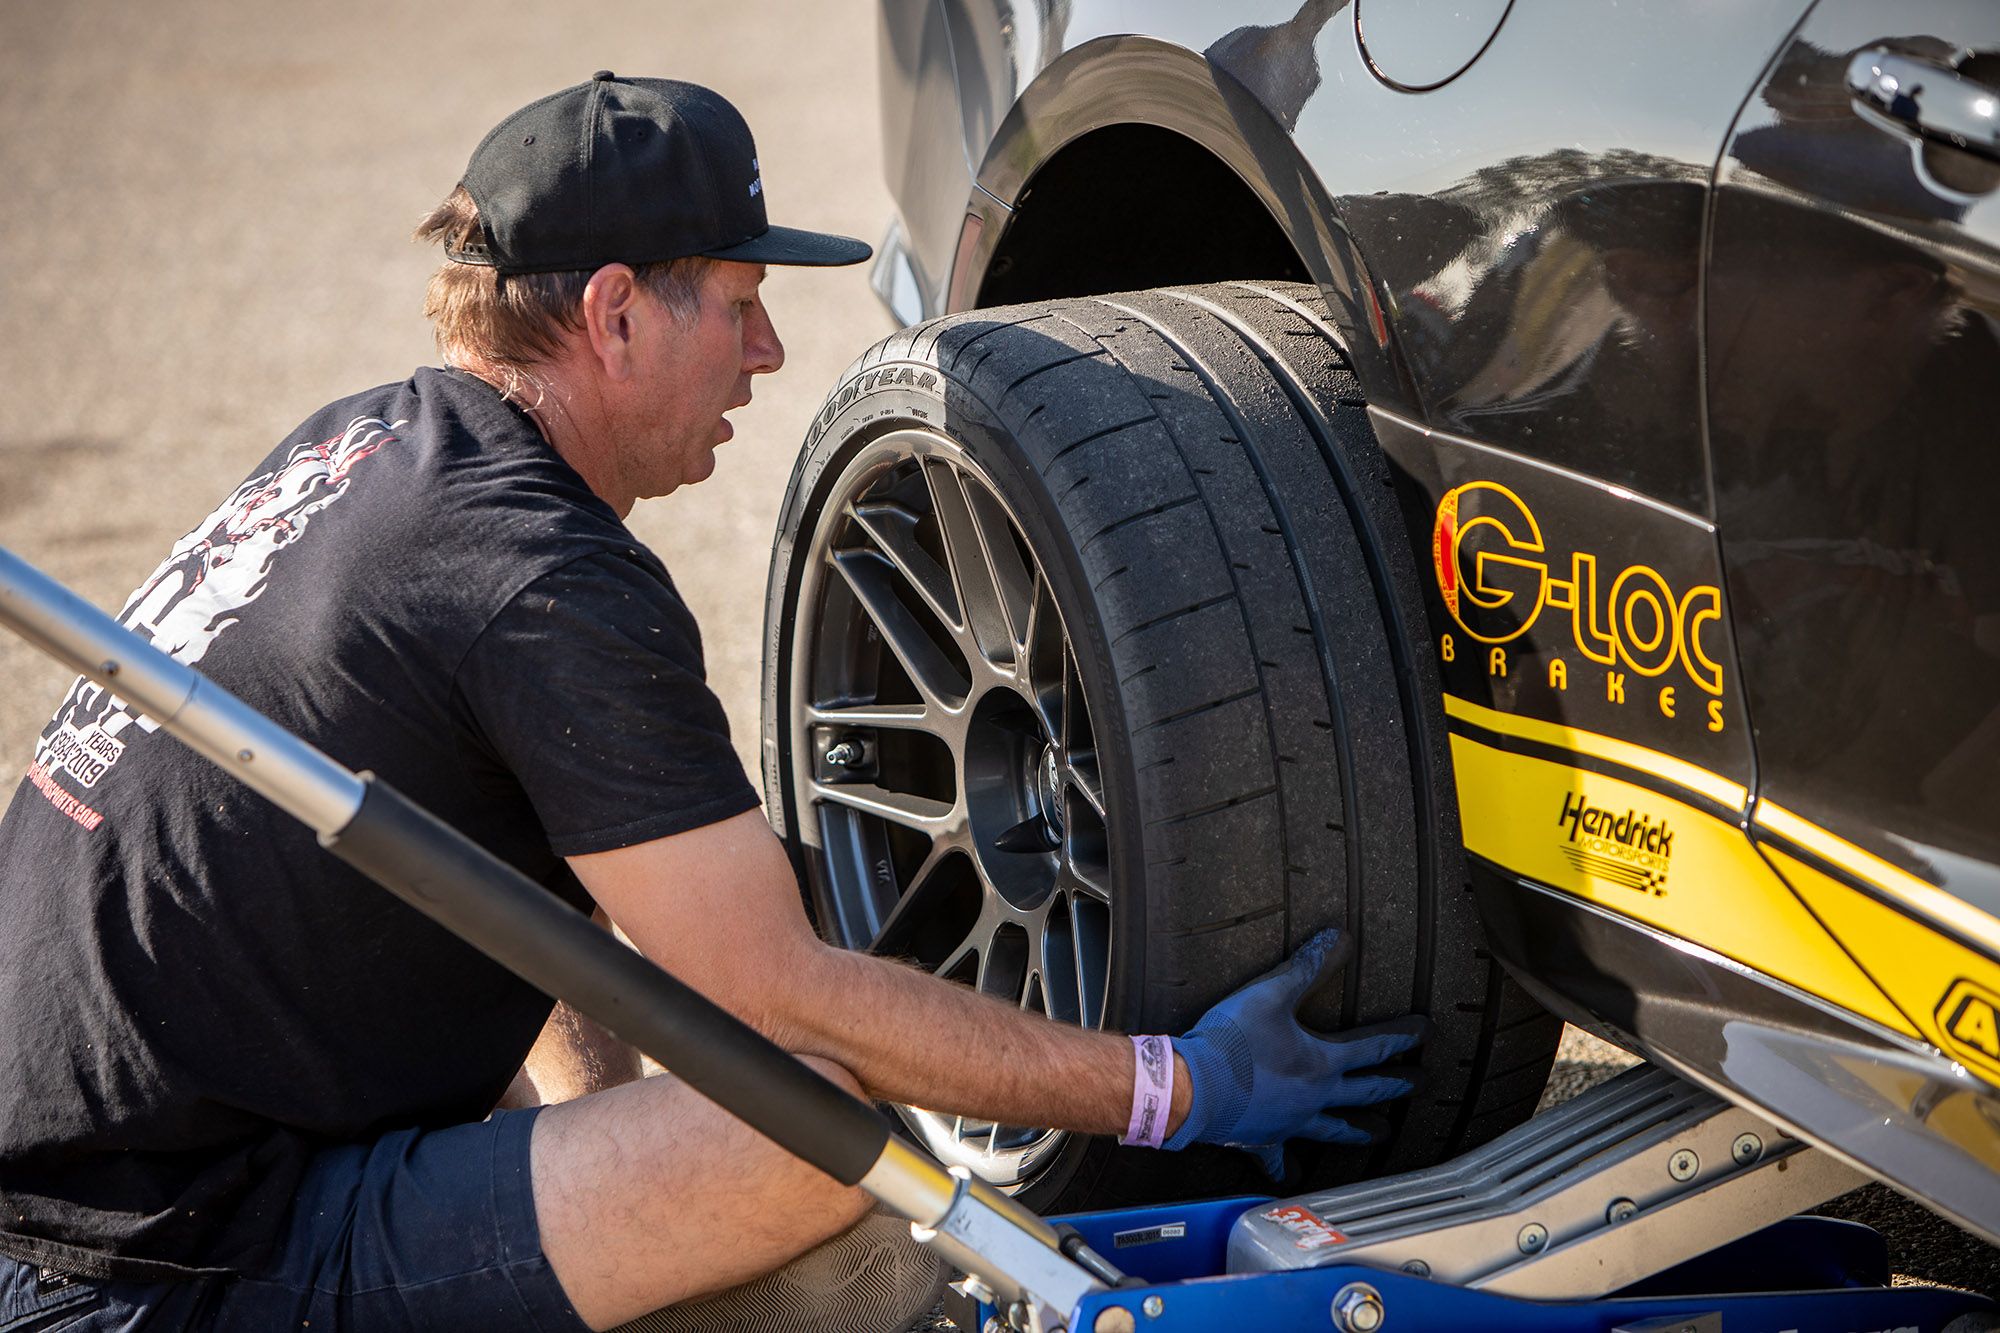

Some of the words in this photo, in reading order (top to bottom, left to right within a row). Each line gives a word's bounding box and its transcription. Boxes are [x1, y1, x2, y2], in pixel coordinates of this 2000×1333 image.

[1441, 633, 1725, 733] BRAKES
[86, 731, 119, 762] YEARS
[1558, 791, 1674, 858] Hendrick
[1578, 836, 1671, 873] MOTORSPORTS
